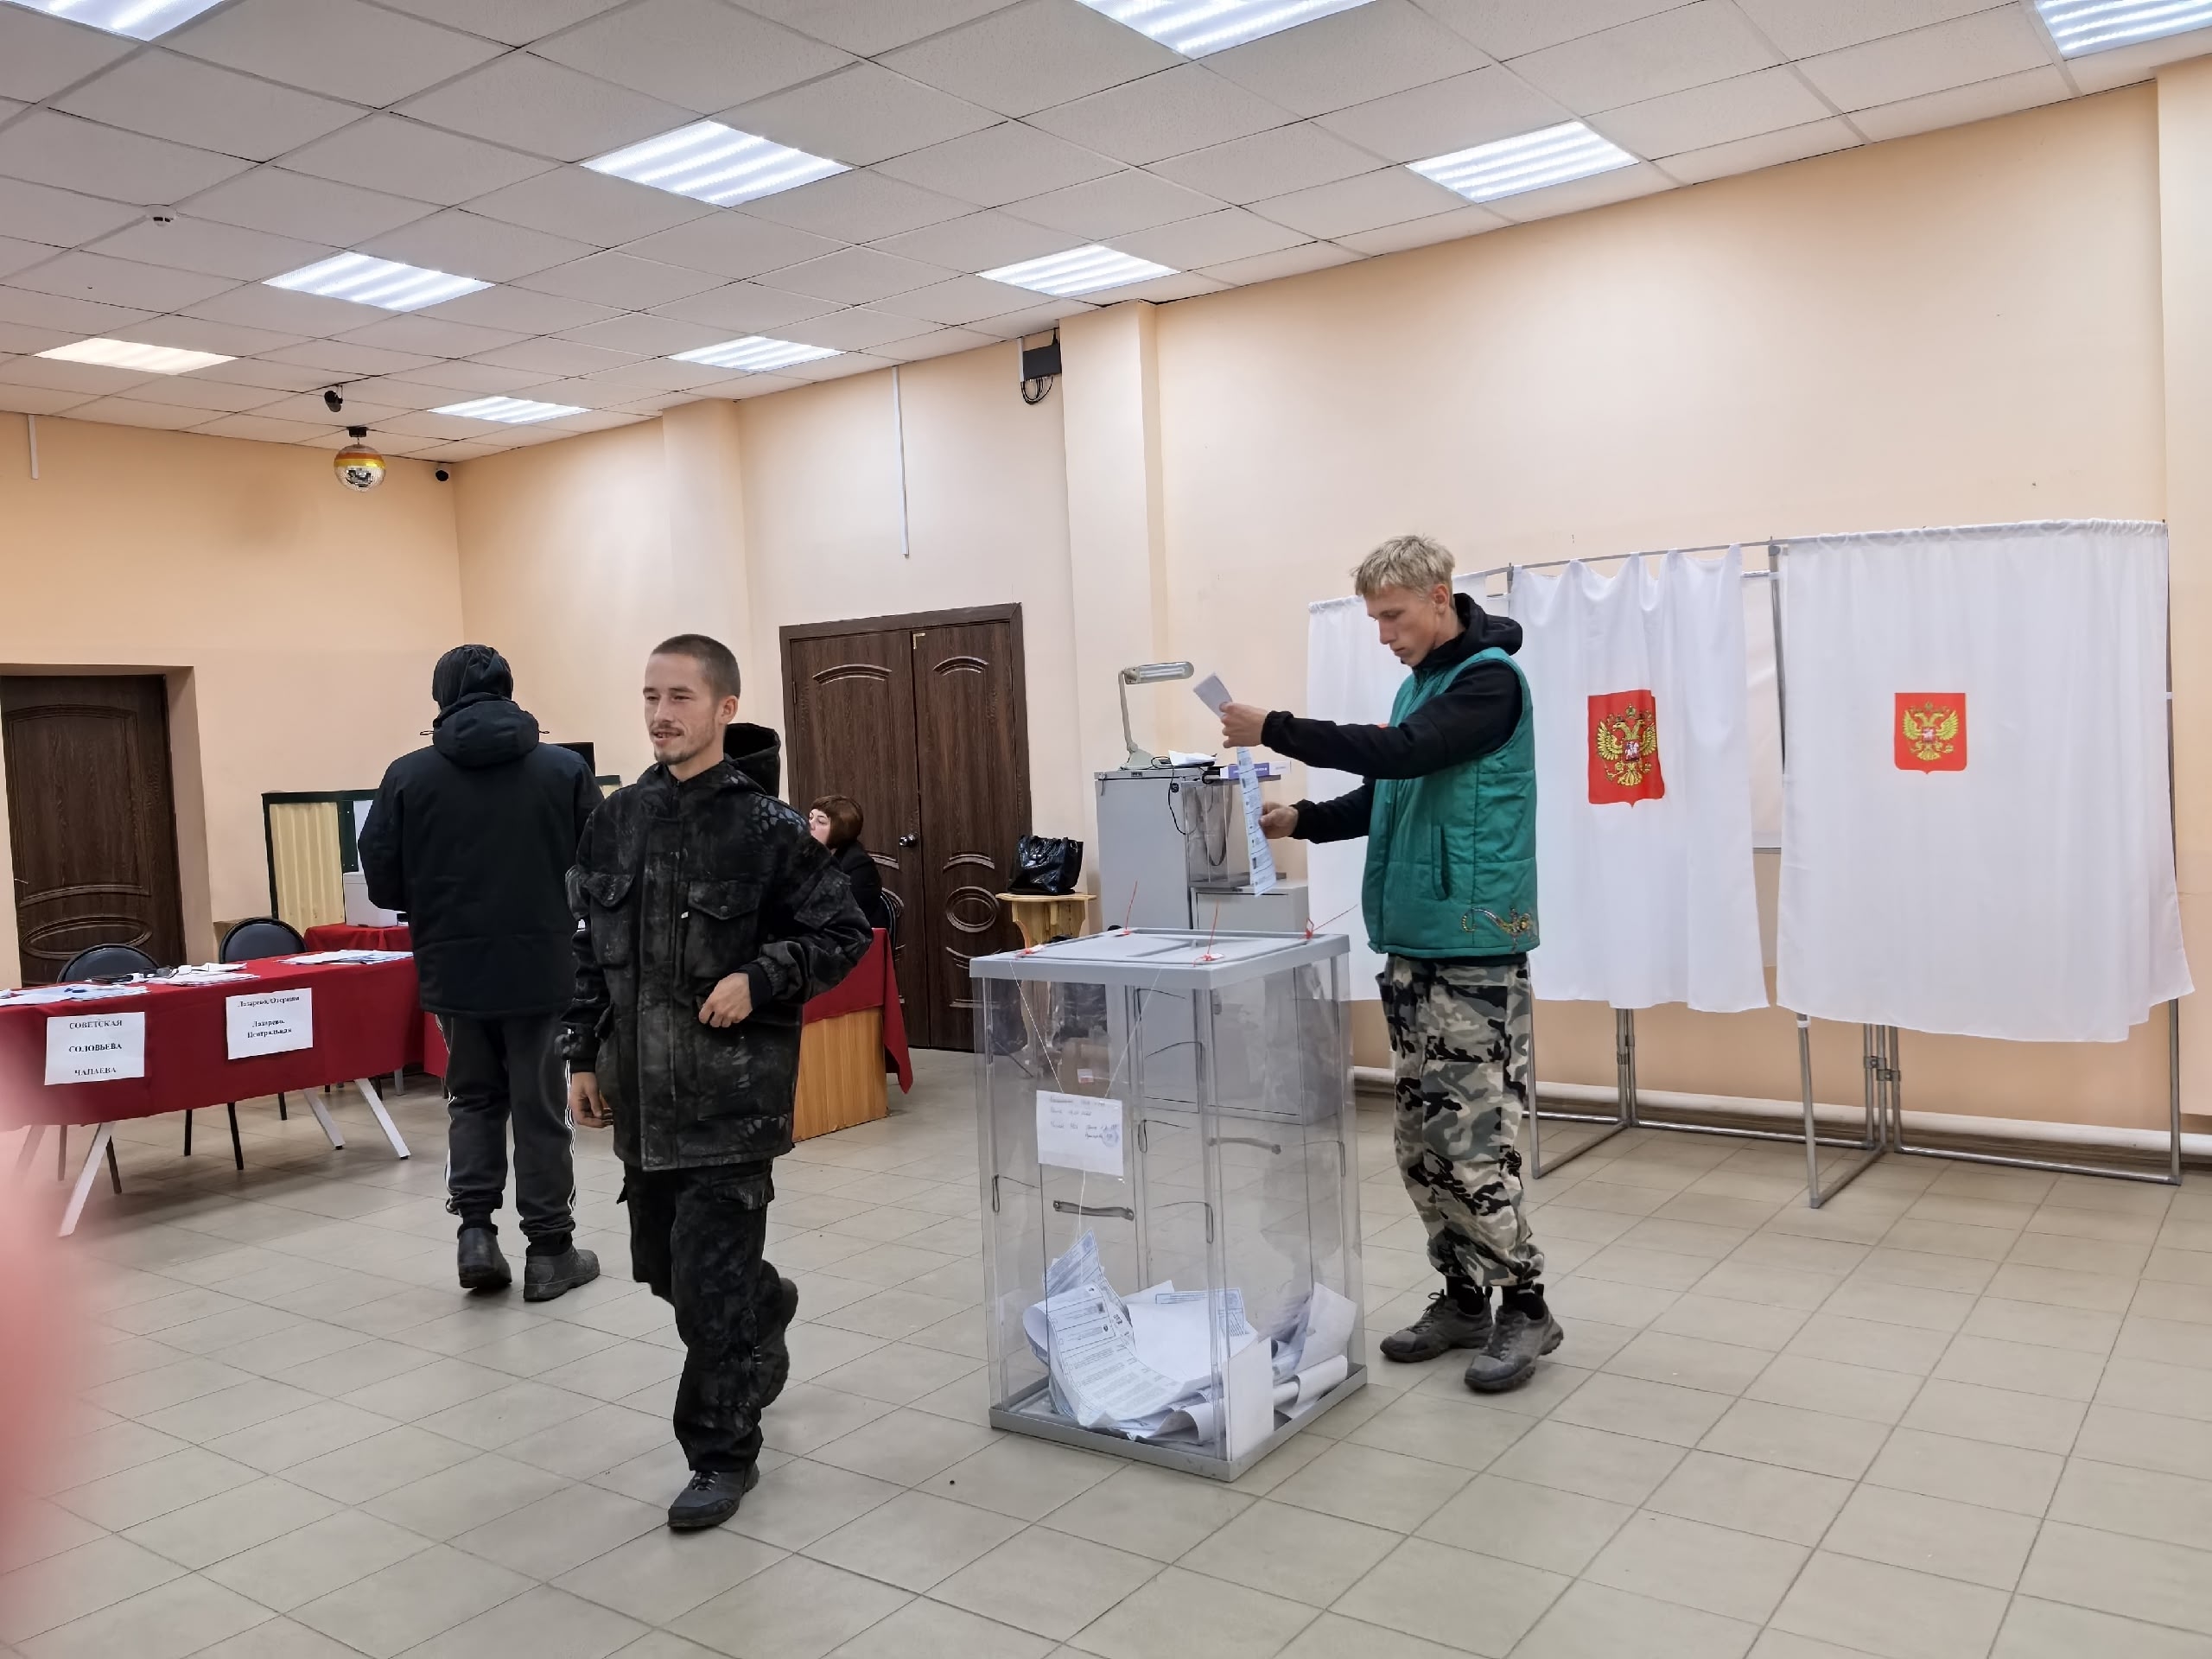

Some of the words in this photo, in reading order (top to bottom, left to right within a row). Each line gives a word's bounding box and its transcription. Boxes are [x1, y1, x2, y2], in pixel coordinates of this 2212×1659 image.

[69, 1020, 123, 1029] СОВЕТСКАЯ
[68, 1043, 123, 1052] СОЛОВЬЕВА
[74, 1067, 117, 1076] ЧАПАЕВА
